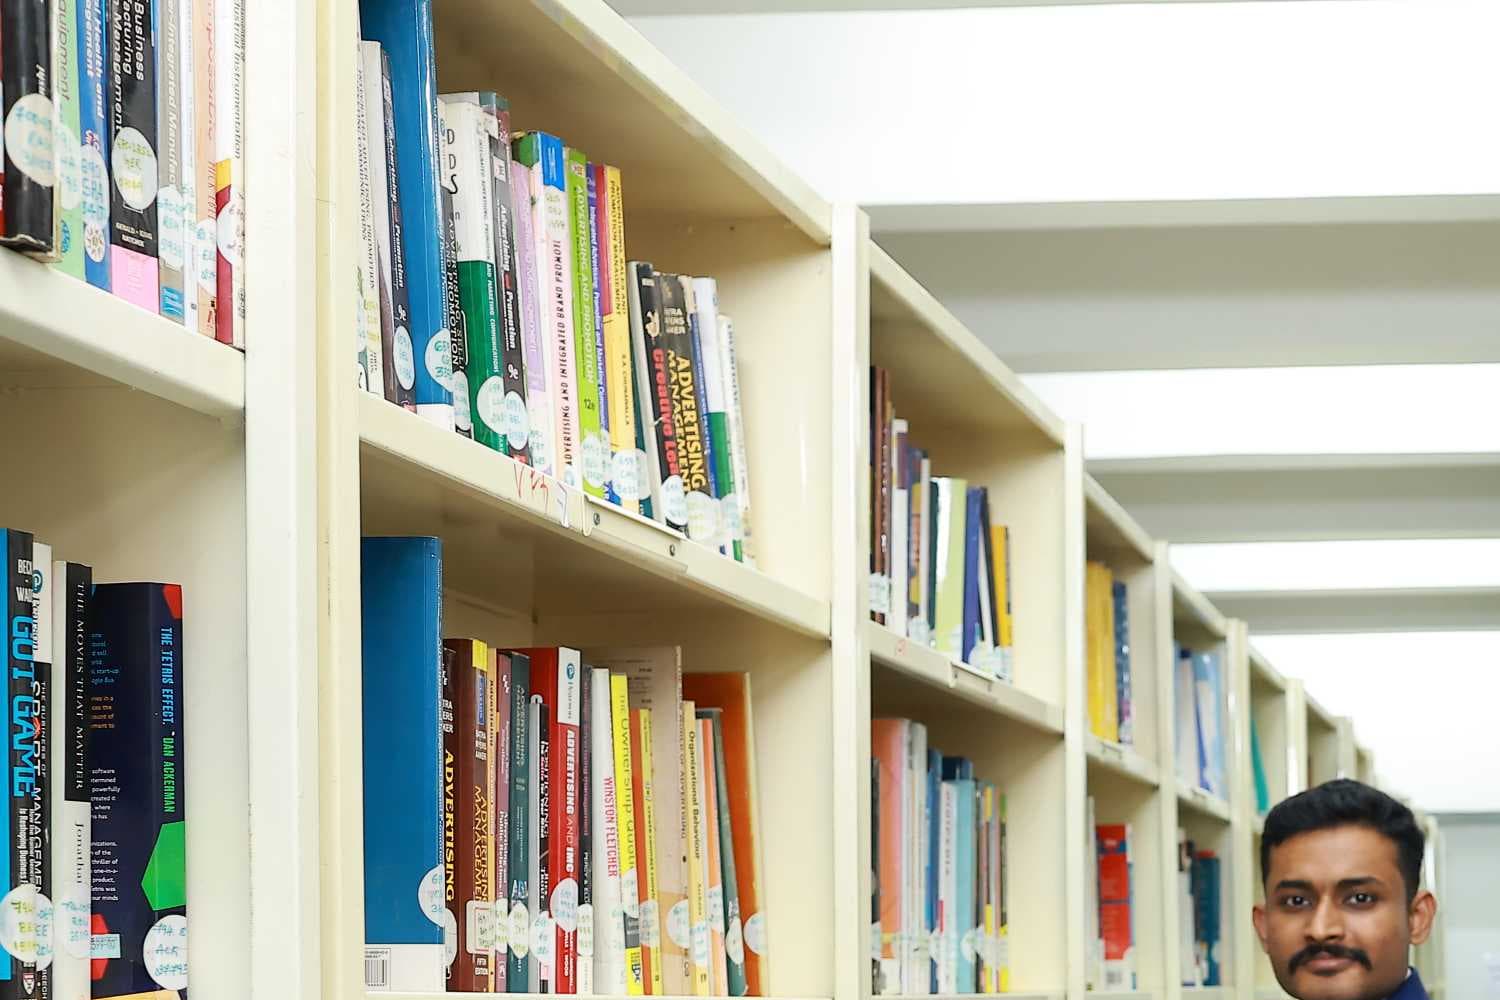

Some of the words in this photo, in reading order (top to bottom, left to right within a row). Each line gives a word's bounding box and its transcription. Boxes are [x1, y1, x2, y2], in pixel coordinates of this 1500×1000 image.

[84, 0, 95, 77] agement
[94, 24, 104, 78] Health
[113, 12, 123, 131] Management
[96, 83, 105, 119] and
[234, 53, 243, 160] Instrumentation
[168, 111, 178, 184] Manufac
[394, 224, 405, 288] Promotion
[577, 187, 589, 270] ADVERTISING
[500, 205, 511, 272] Advertising
[506, 291, 517, 349] Promotion
[556, 286, 566, 318] BRAND
[581, 276, 591, 302] AND
[446, 272, 459, 366] PROMOTION
[582, 305, 595, 384] PROMOTION
[558, 322, 569, 379] INTEGRATED
[560, 383, 570, 401] AND
[652, 347, 674, 436] Creative
[562, 407, 574, 466] ADVERTISING
[667, 350, 690, 492] MANAGEMENT
[676, 356, 706, 490] ADVERTISING
[662, 440, 679, 476] Lea
[76, 582, 85, 614] THE
[11, 615, 36, 688] GUT
[75, 620, 85, 673] MOVES
[161, 627, 173, 645] THE
[161, 650, 174, 684] TETRIS
[75, 678, 85, 720] THAT
[162, 689, 174, 725] EFFECT.
[13, 695, 37, 798] GAME
[75, 726, 84, 789] MATTER
[162, 737, 175, 757] DAN
[565, 729, 576, 815] ADVERTISING
[163, 761, 176, 813] ACKERMAN
[603, 777, 616, 824] WINSTON
[33, 787, 43, 893] MANAGEMEN
[444, 749, 456, 902] ADVERTISING
[566, 819, 575, 844] AND
[606, 826, 619, 878] FLETCHER
[694, 808, 704, 859] Behaviour
[566, 847, 576, 873] IMC
